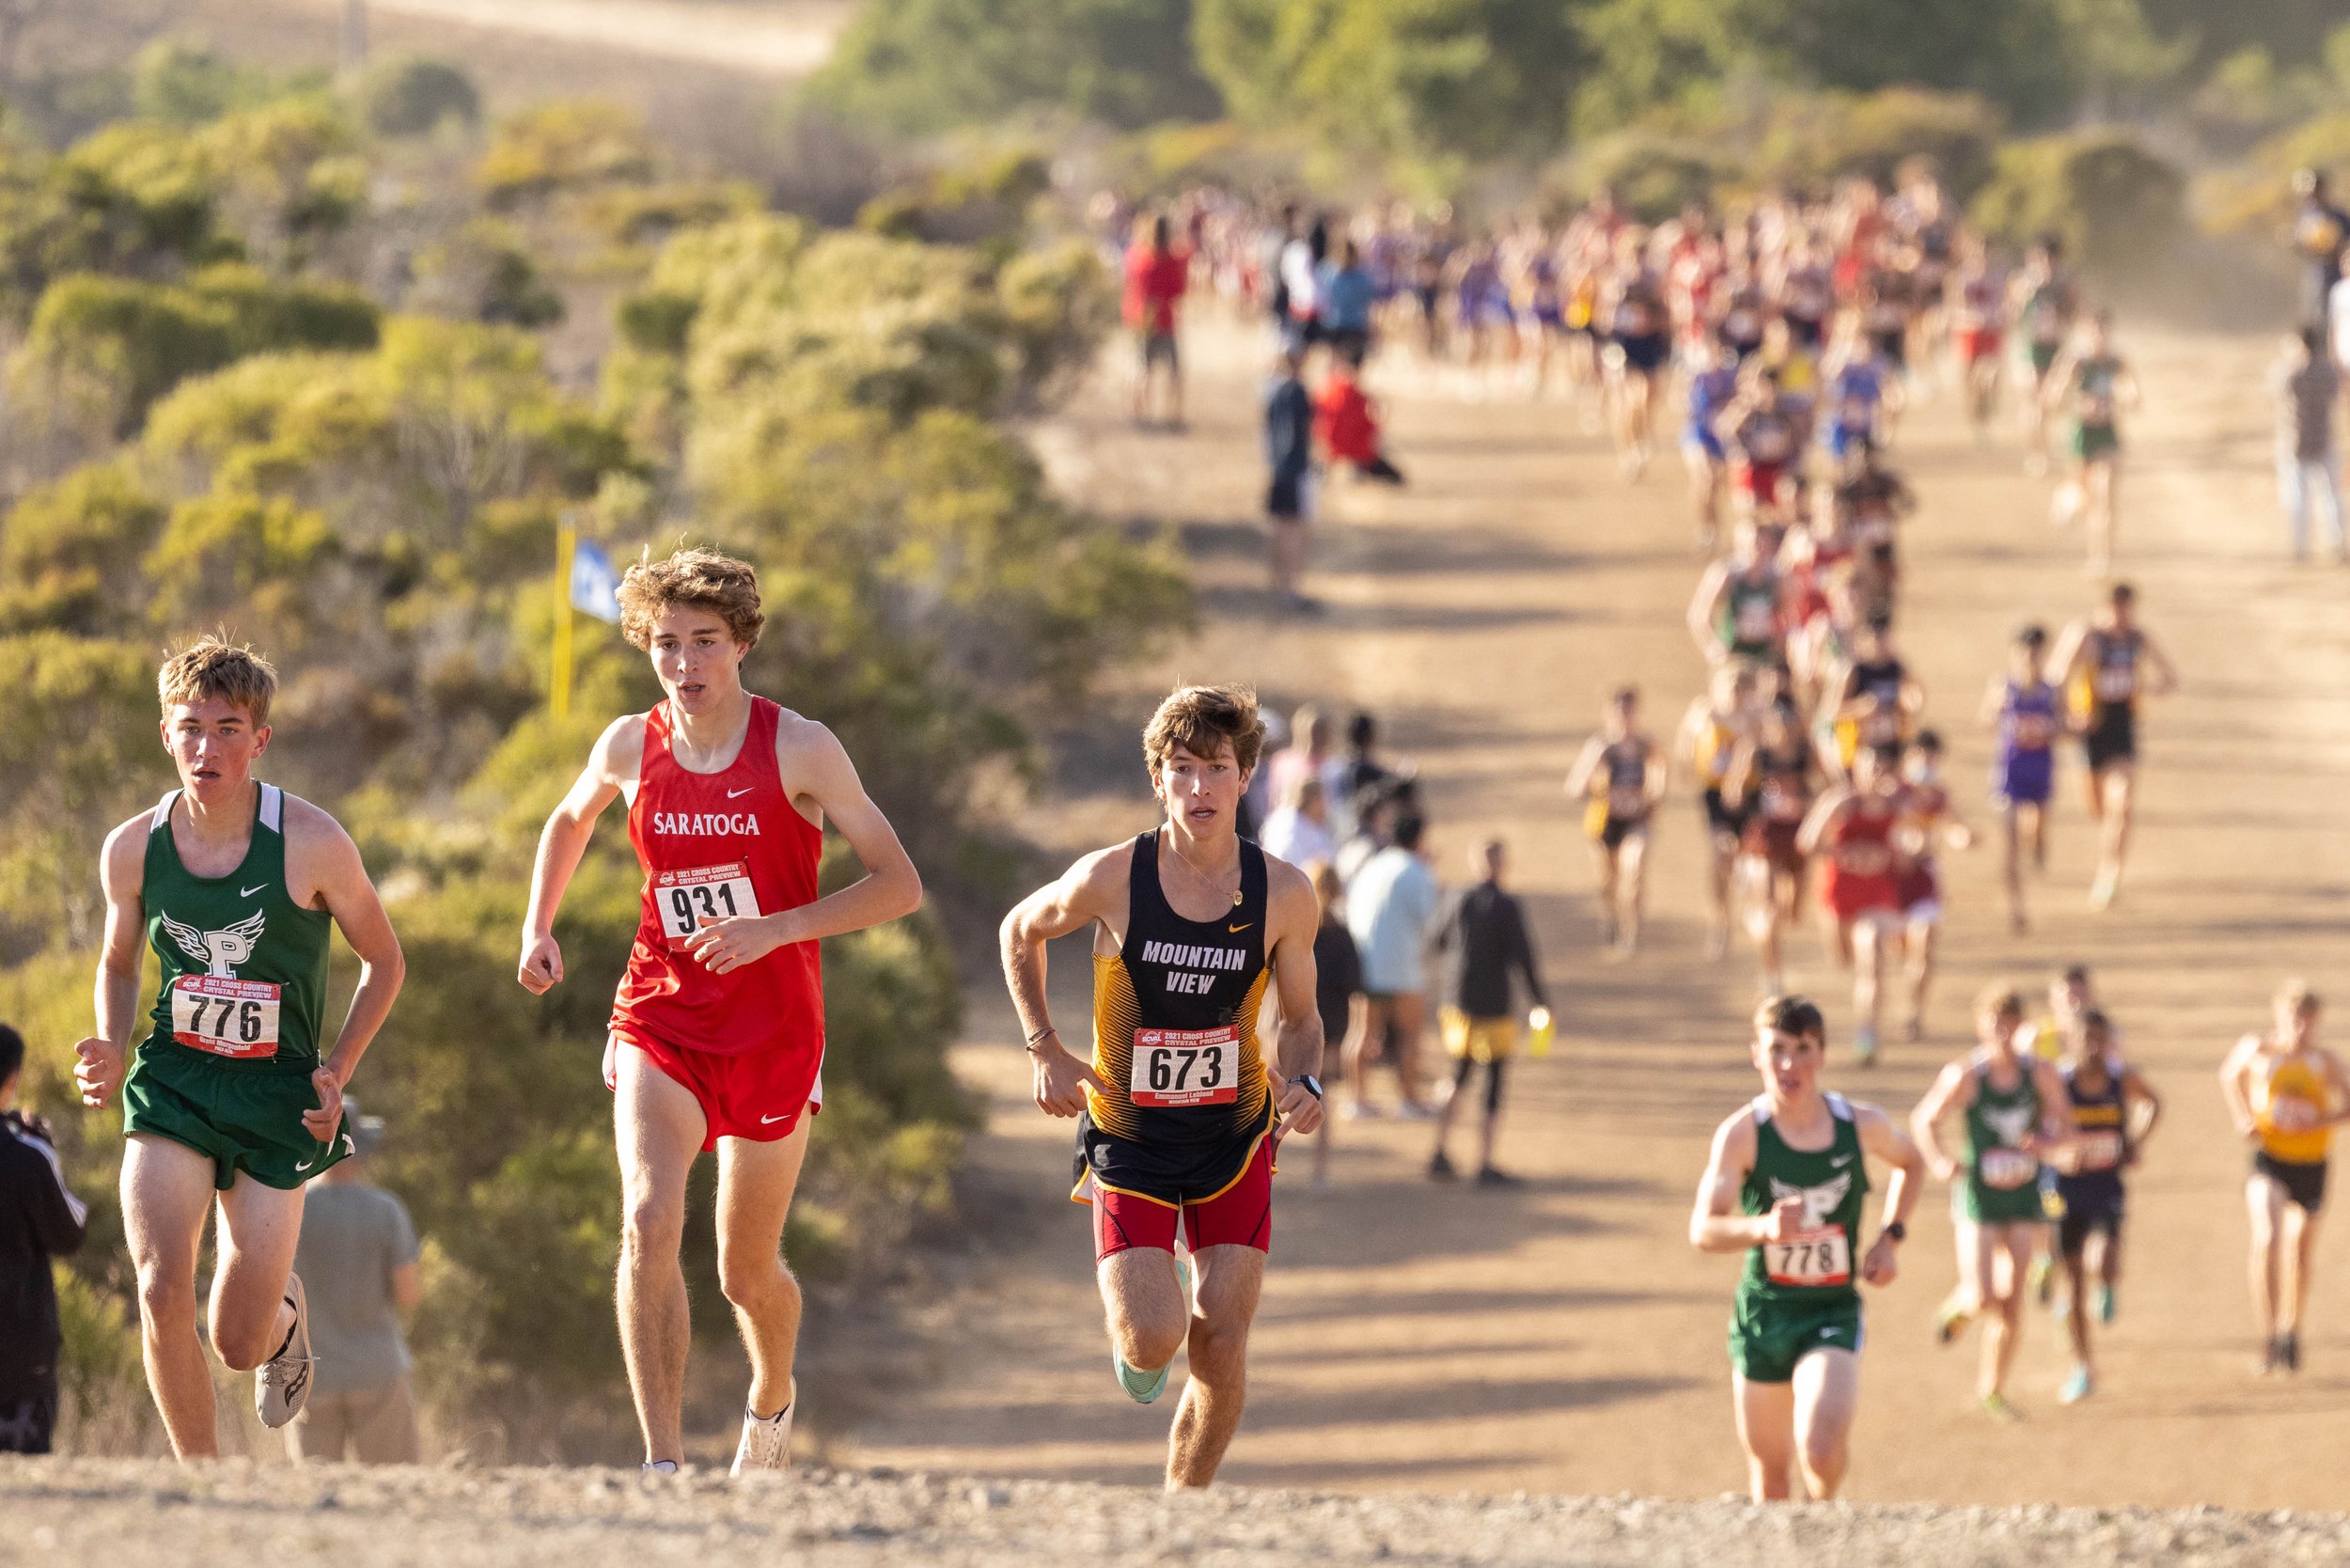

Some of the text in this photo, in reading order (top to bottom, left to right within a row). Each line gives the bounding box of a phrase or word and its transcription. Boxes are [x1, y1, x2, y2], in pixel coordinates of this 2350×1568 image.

[653, 812, 760, 836] SARATOGA
[679, 870, 741, 885] CRYSTAL PREVIEW
[691, 868, 711, 877] CROSS
[712, 864, 739, 873] COUNTRY
[671, 883, 738, 934] 931
[203, 931, 250, 980] P
[1141, 940, 1246, 971] MOUNTAIN
[203, 986, 272, 999] CRYSTAL PREVIEW
[204, 978, 273, 993] 2021 CROSS COUNTRY
[1166, 971, 1216, 995] VIEW
[190, 995, 261, 1043] 776
[1165, 1031, 1181, 1040] 2021
[1204, 1027, 1231, 1038] COUNTRY
[1198, 1034, 1231, 1045] PREVIEW
[1149, 1045, 1222, 1091] 673
[1781, 1244, 1833, 1273] 778
